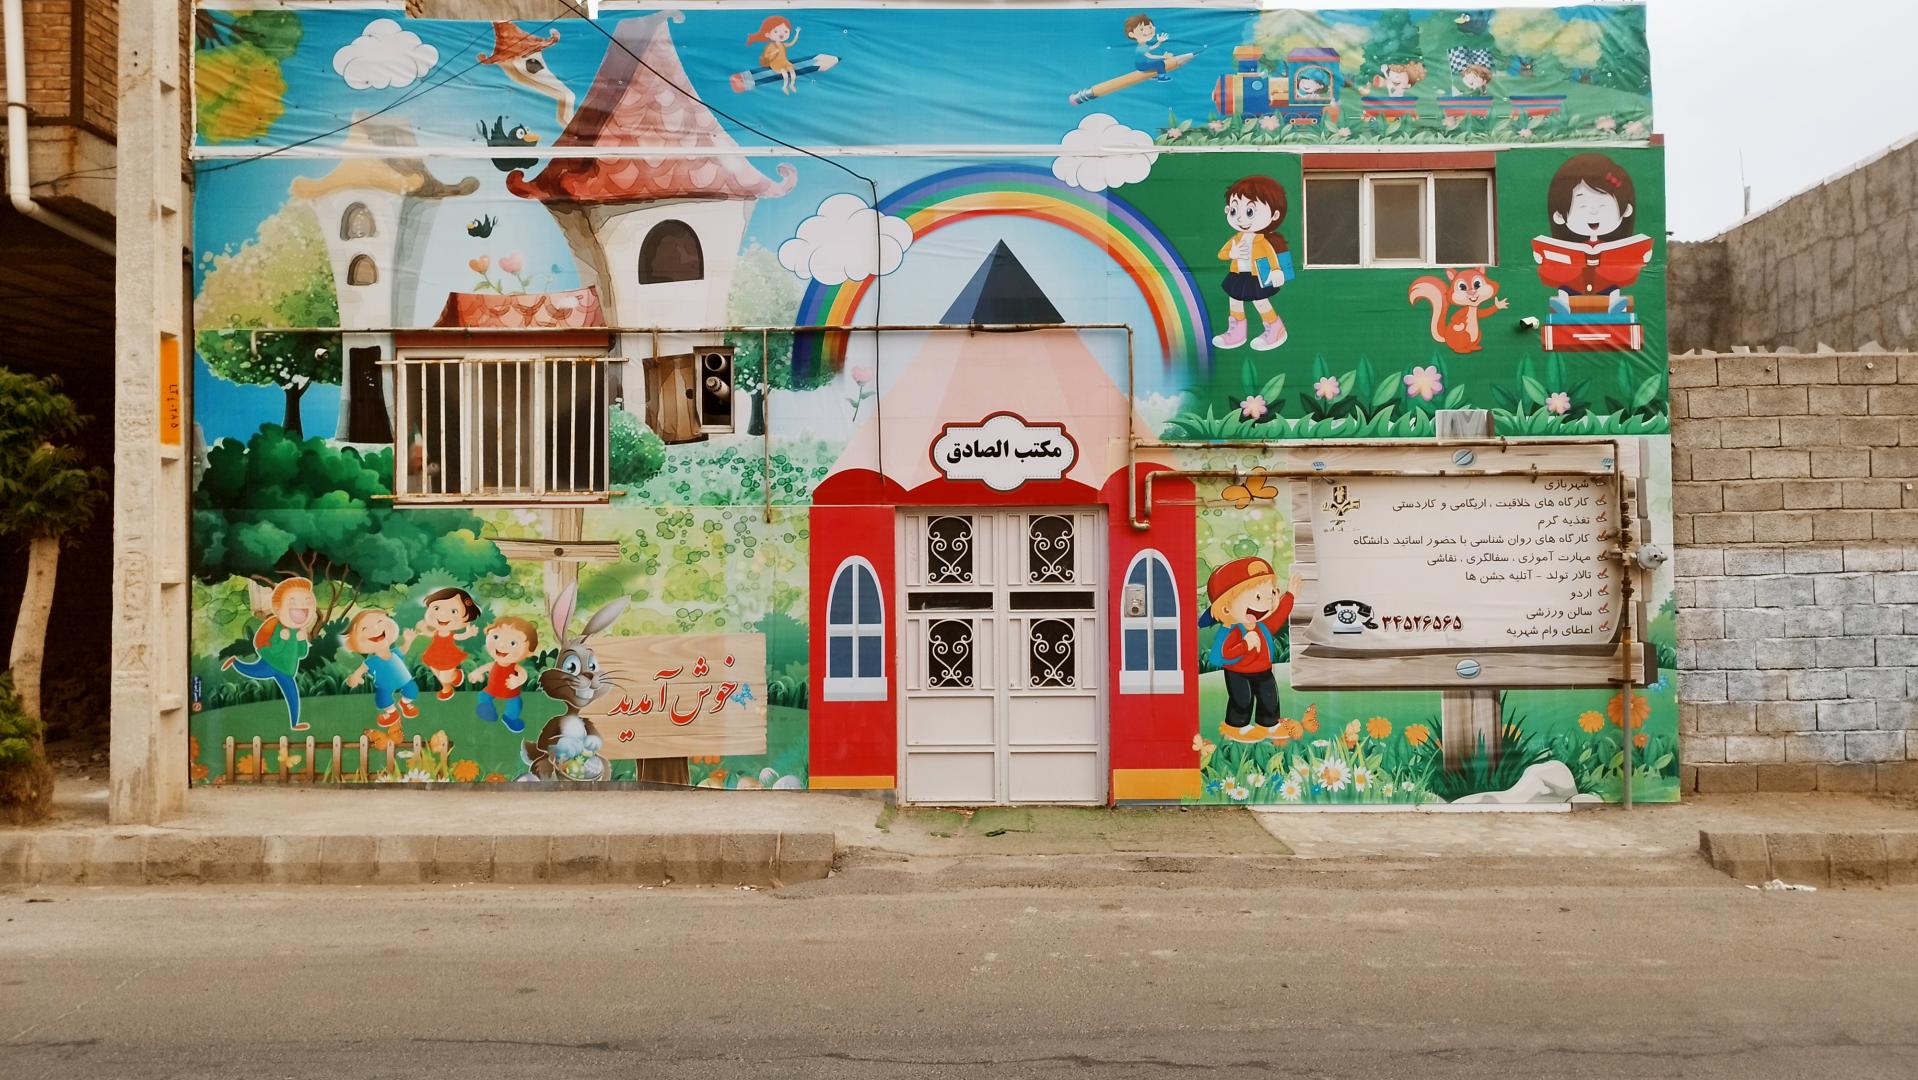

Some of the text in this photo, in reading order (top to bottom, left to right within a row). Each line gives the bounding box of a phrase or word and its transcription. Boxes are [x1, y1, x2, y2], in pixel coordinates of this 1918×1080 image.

[946, 439, 1062, 464] مکتب الصادق
[1392, 498, 1437, 512] کاردستی
[1439, 502, 1447, 511] و
[1495, 497, 1531, 510] خلاقیت
[1534, 497, 1555, 510] های
[1562, 515, 1590, 527] تغذیه
[1353, 535, 1390, 545] دانشگاه
[1393, 535, 1424, 547] اساتید
[1426, 535, 1457, 548] حضور
[1459, 534, 1467, 545] با
[1470, 534, 1505, 548] شناسی
[1507, 534, 1532, 547] روان
[1534, 533, 1556, 546] های
[1426, 553, 1458, 567] نقاشی
[1466, 552, 1510, 566] سفالگری
[1518, 550, 1555, 566] آموزی
[1557, 551, 1591, 564] مهارت
[1465, 571, 1477, 582] ها
[1479, 571, 1506, 585] جشن
[1508, 569, 1533, 584] آتلیه
[1546, 570, 1569, 584] تولد
[1571, 569, 1592, 582] تالار
[1569, 587, 1593, 601] اردو
[1526, 606, 1593, 621] سالن ورزشی
[1381, 614, 1464, 633] ۳۴۵۲۶۵۶۵
[1506, 624, 1594, 640] اعطای وام شهریه
[606, 654, 738, 743] خوش آمدید
